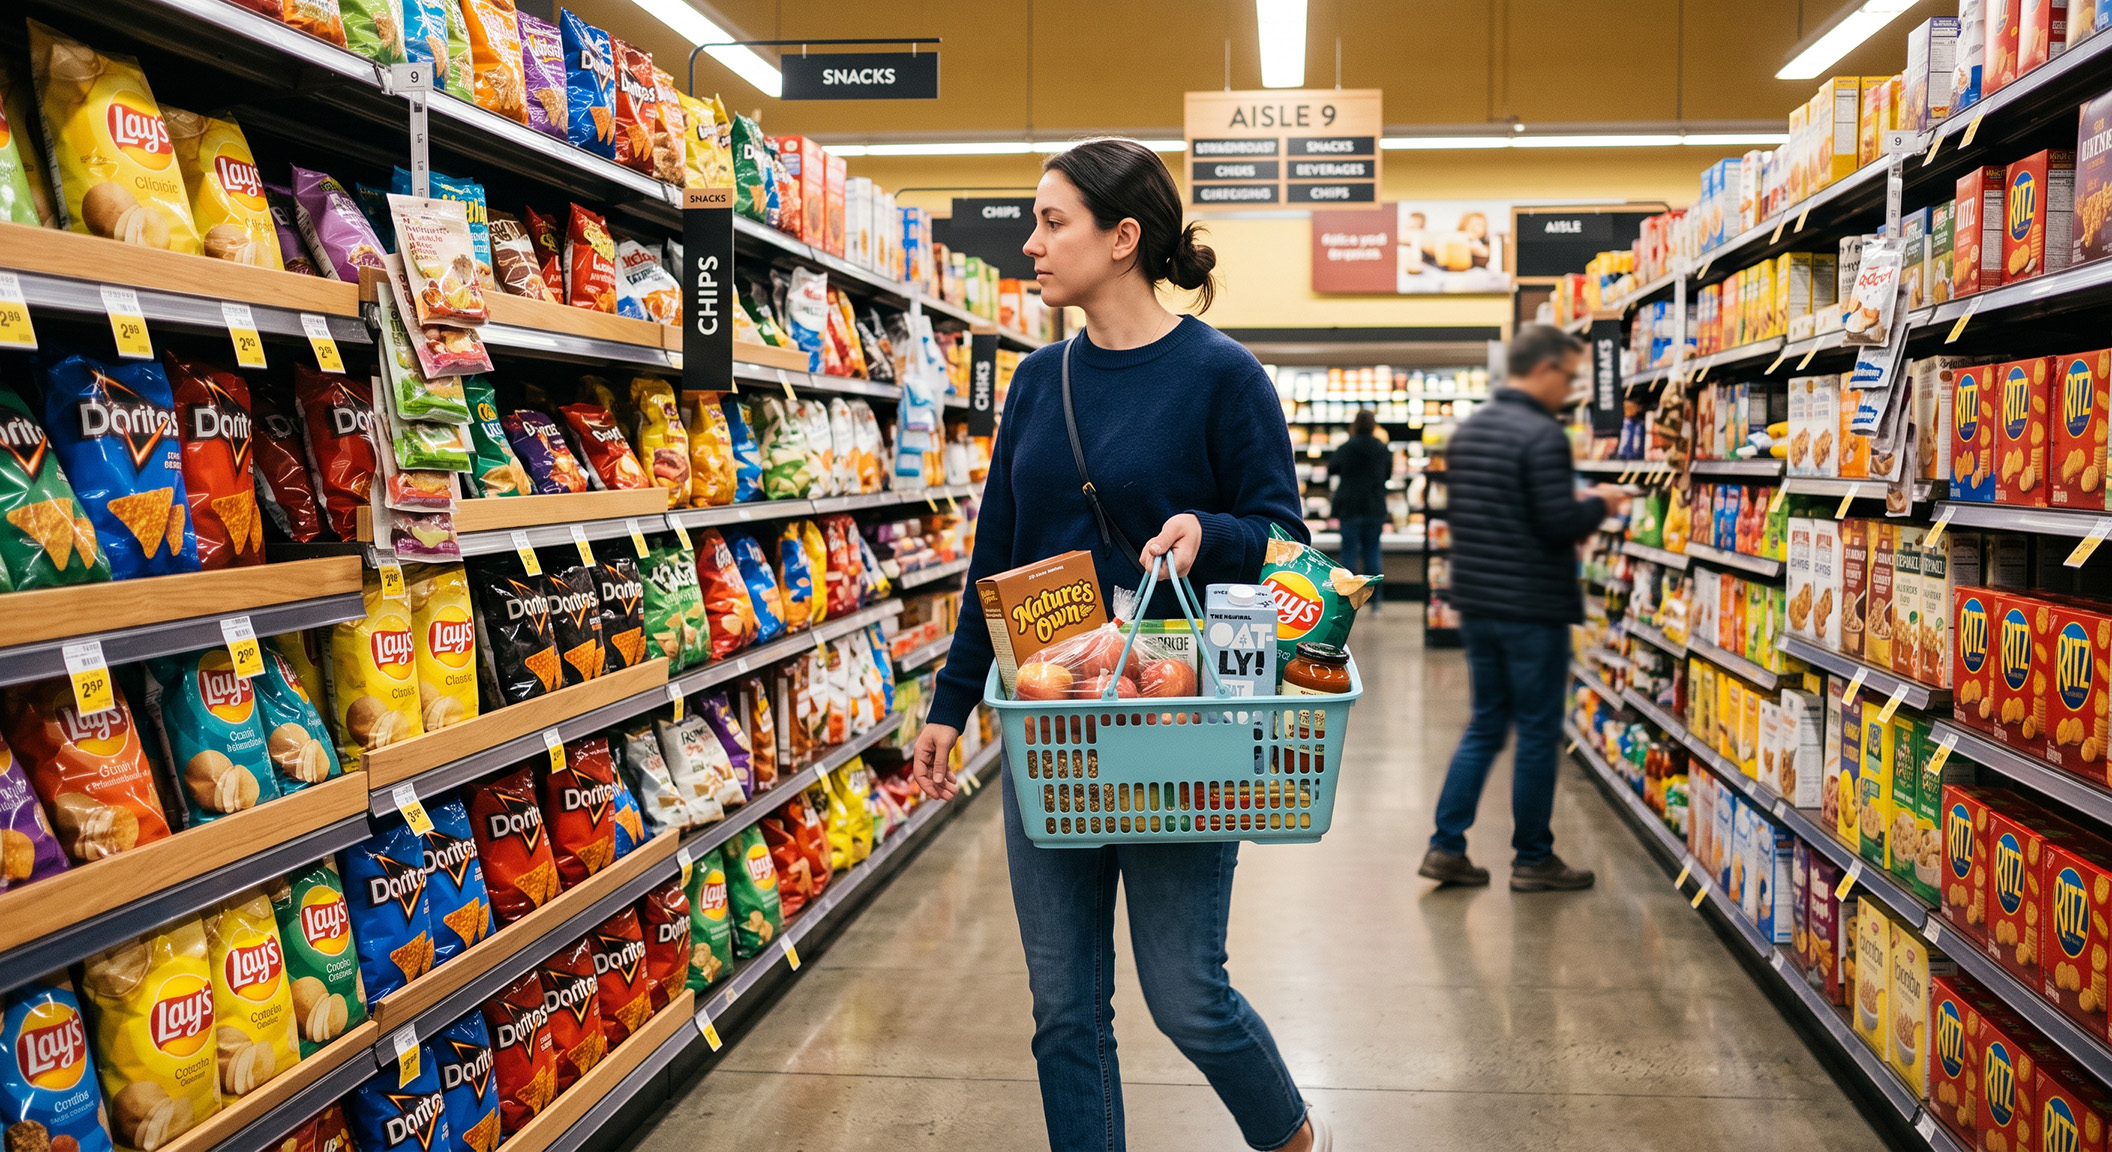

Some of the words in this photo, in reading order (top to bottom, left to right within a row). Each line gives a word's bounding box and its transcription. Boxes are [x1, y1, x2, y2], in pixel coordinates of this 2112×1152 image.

[410, 71, 419, 83] 9
[823, 68, 896, 85] SNACKS
[115, 106, 170, 154] Lay's
[1229, 105, 1310, 128] AISLE
[1321, 105, 1336, 127] 9
[1894, 137, 1901, 146] 9
[220, 158, 261, 197] Lay's
[1296, 163, 1366, 176] BEVERAGES
[690, 194, 727, 203] SNACKS
[2009, 180, 2036, 236] RITZ
[698, 256, 719, 335] CHIPS
[80, 403, 180, 437] Doritos
[1957, 384, 1978, 429] RITZ
[2003, 377, 2029, 428] RITZ
[2064, 370, 2093, 425] RITZ
[195, 408, 252, 440] Dorit
[1012, 580, 1095, 634] Nature's
[1037, 604, 1081, 643] Own
[375, 628, 413, 665] Lay's
[434, 619, 473, 655] Lay's
[1960, 608, 1987, 658] RITZ
[2001, 618, 2030, 675] RITZ
[1219, 650, 1265, 676] LY!
[2057, 633, 2092, 693] RITZ
[565, 784, 615, 811] Dorito
[428, 837, 478, 874] Doritos
[1947, 810, 1973, 863] RITZ
[1995, 840, 2024, 899] RITZ
[305, 898, 347, 941] Lay's
[2054, 876, 2088, 939] RITZ
[232, 940, 279, 990] Lay's
[158, 987, 212, 1043] Lay's
[498, 1004, 548, 1049] Doritos
[1937, 1004, 1964, 1064] RITZ
[25, 1014, 82, 1077] Lay's
[1985, 1045, 2014, 1114] RITZ
[386, 1093, 442, 1146] Dorito
